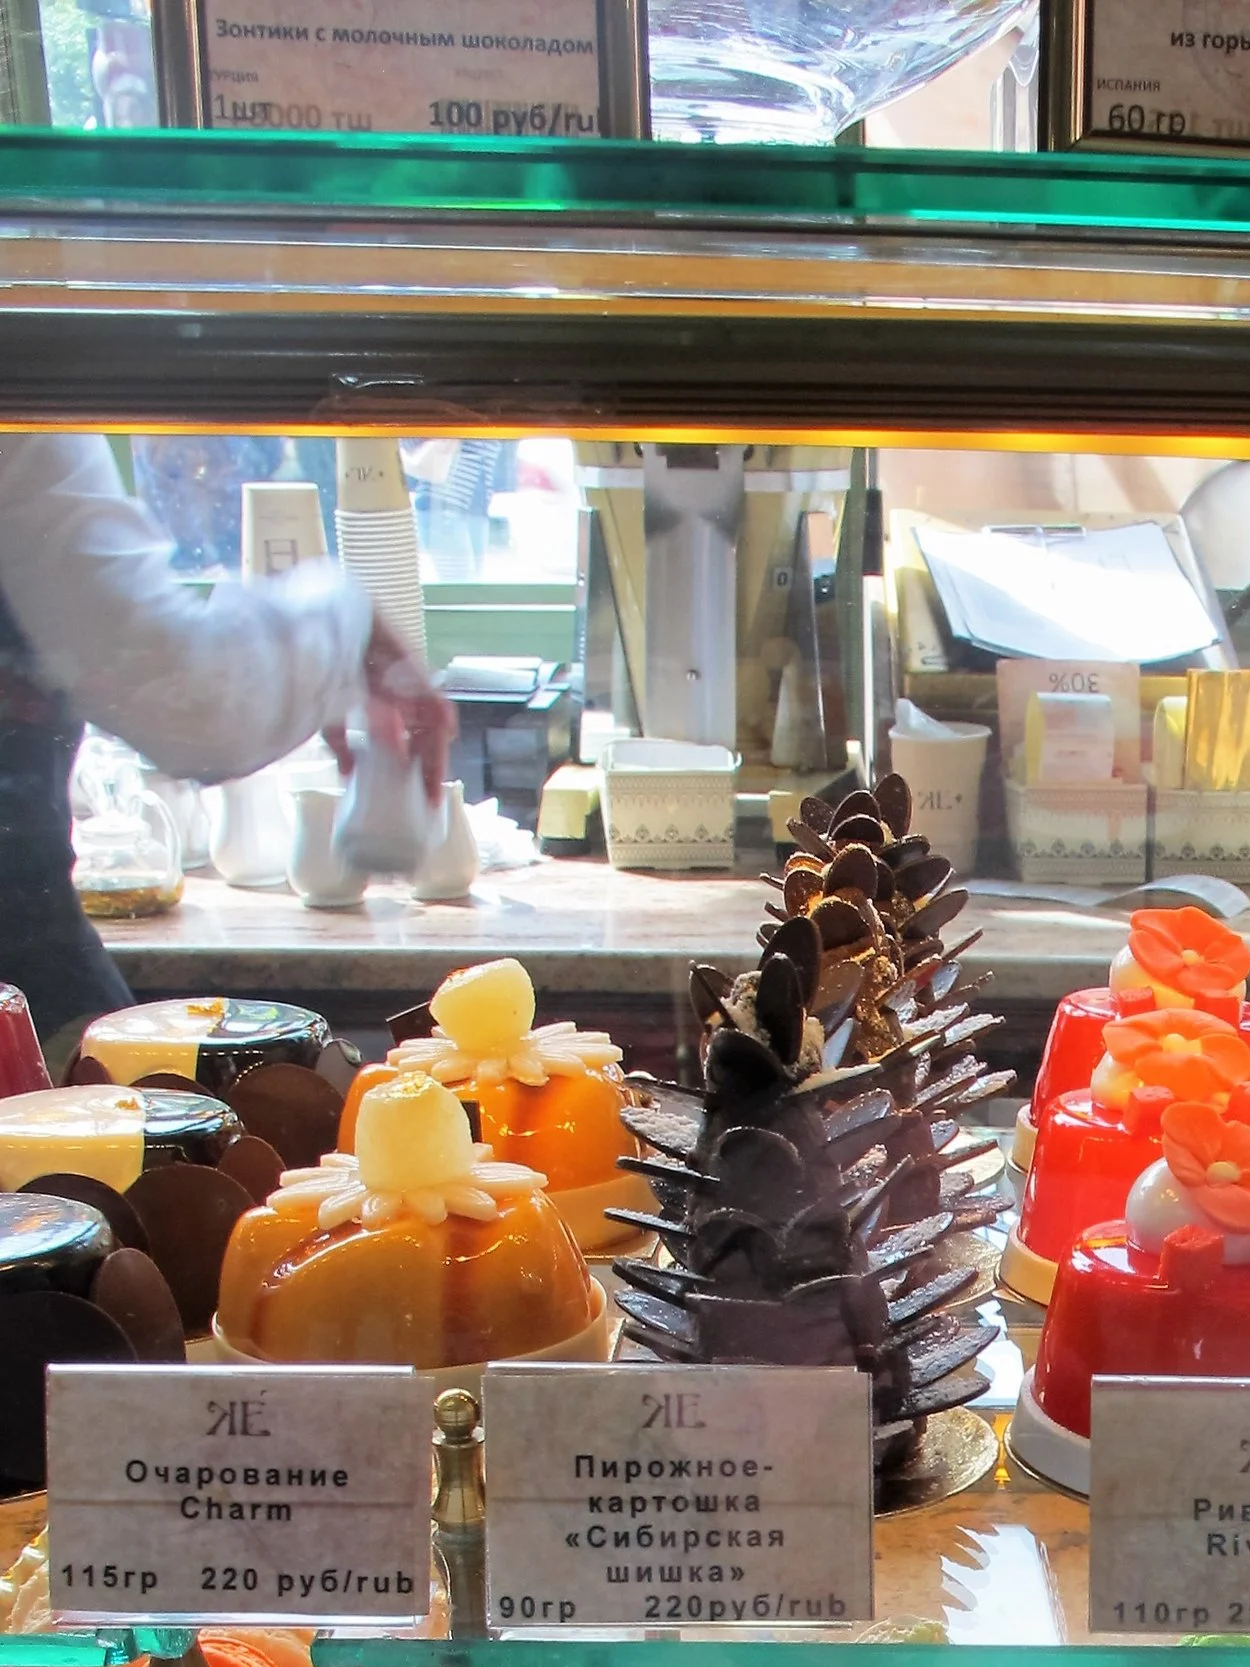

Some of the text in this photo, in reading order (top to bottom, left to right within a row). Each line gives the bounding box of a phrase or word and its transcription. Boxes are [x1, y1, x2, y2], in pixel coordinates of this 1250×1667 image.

[215, 18, 595, 57] Зонтики с молочным шоколадом
[1170, 30, 1196, 49] из
[1096, 79, 1161, 93] ИСПАНИЯ
[428, 100, 601, 137] 100 руб/ru
[1108, 102, 1146, 132] 60
[1155, 109, 1186, 136] гр
[125, 1459, 349, 1489] Очарование
[573, 1453, 774, 1484] Пирожное-
[180, 1495, 293, 1522] Charm
[588, 1492, 762, 1517] картошка
[564, 1523, 786, 1553] «Сибирская
[61, 1563, 415, 1598] 115гр 220 руб/rub
[606, 1563, 745, 1585] шишка»
[498, 1592, 846, 1623] 90гр 220руб/rub
[1112, 1601, 1211, 1630] 110гр
